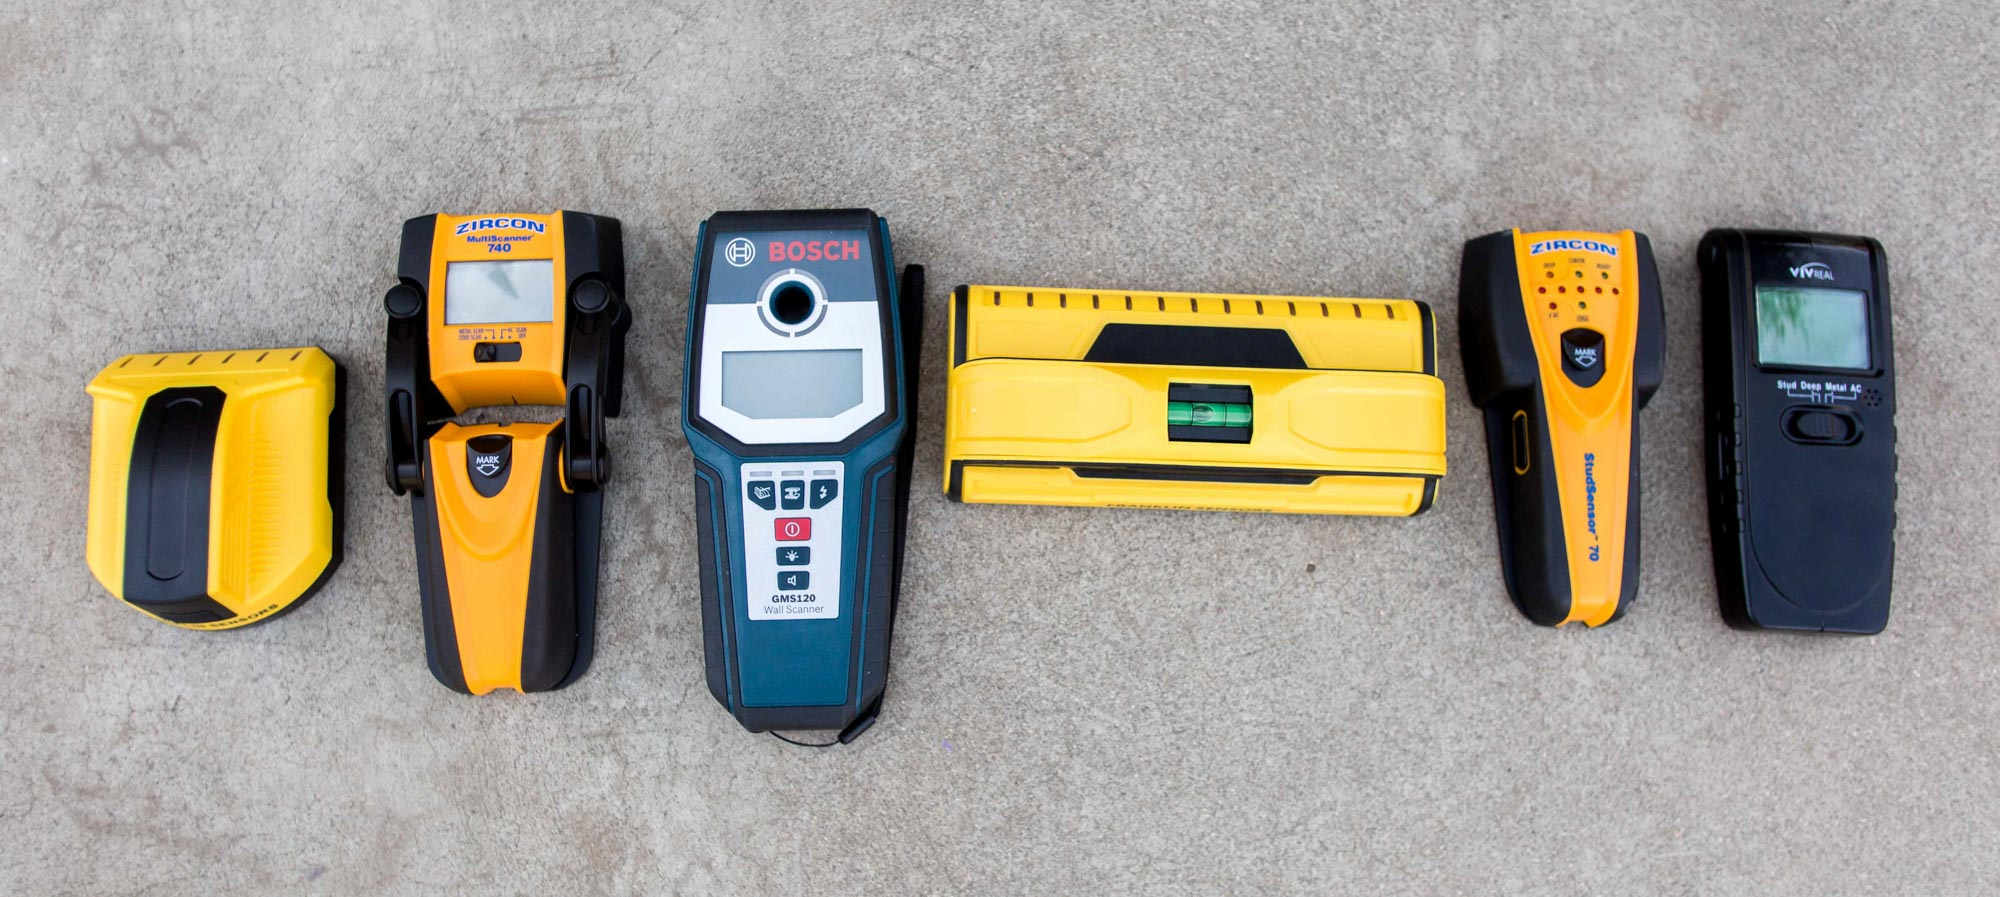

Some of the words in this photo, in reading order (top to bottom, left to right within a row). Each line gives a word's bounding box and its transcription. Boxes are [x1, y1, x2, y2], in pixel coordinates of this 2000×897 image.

[455, 218, 545, 235] ZIRCON
[488, 243, 511, 253] 740
[769, 240, 860, 262] BOSCH
[1531, 240, 1617, 256] ZIRCON
[1575, 347, 1597, 356] MARK
[1777, 380, 1796, 390] Stud
[1801, 381, 1821, 391] Deep
[1825, 382, 1847, 392] Metal
[1850, 383, 1862, 393] AC
[476, 455, 500, 464] MARK
[1589, 545, 1599, 561] 70
[772, 594, 816, 604] GMS120
[764, 606, 784, 615] Wall
[786, 605, 825, 614] Scanner
